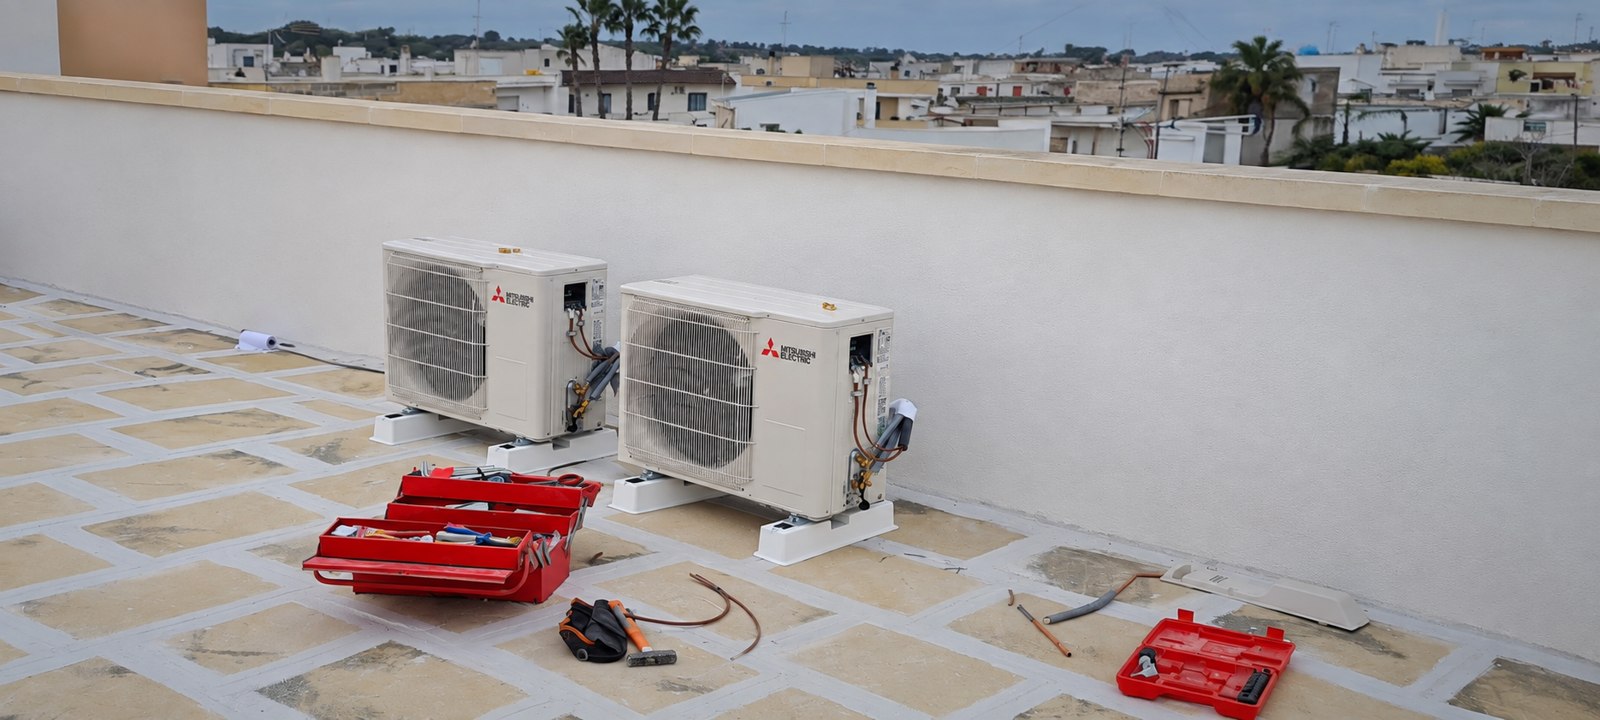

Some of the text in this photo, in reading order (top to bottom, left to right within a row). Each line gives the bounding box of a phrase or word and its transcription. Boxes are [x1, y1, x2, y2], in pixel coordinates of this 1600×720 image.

[506, 297, 530, 308] ELECTRIC
[781, 345, 816, 359] MITSUBISHI
[781, 352, 811, 364] ELECTRIC
